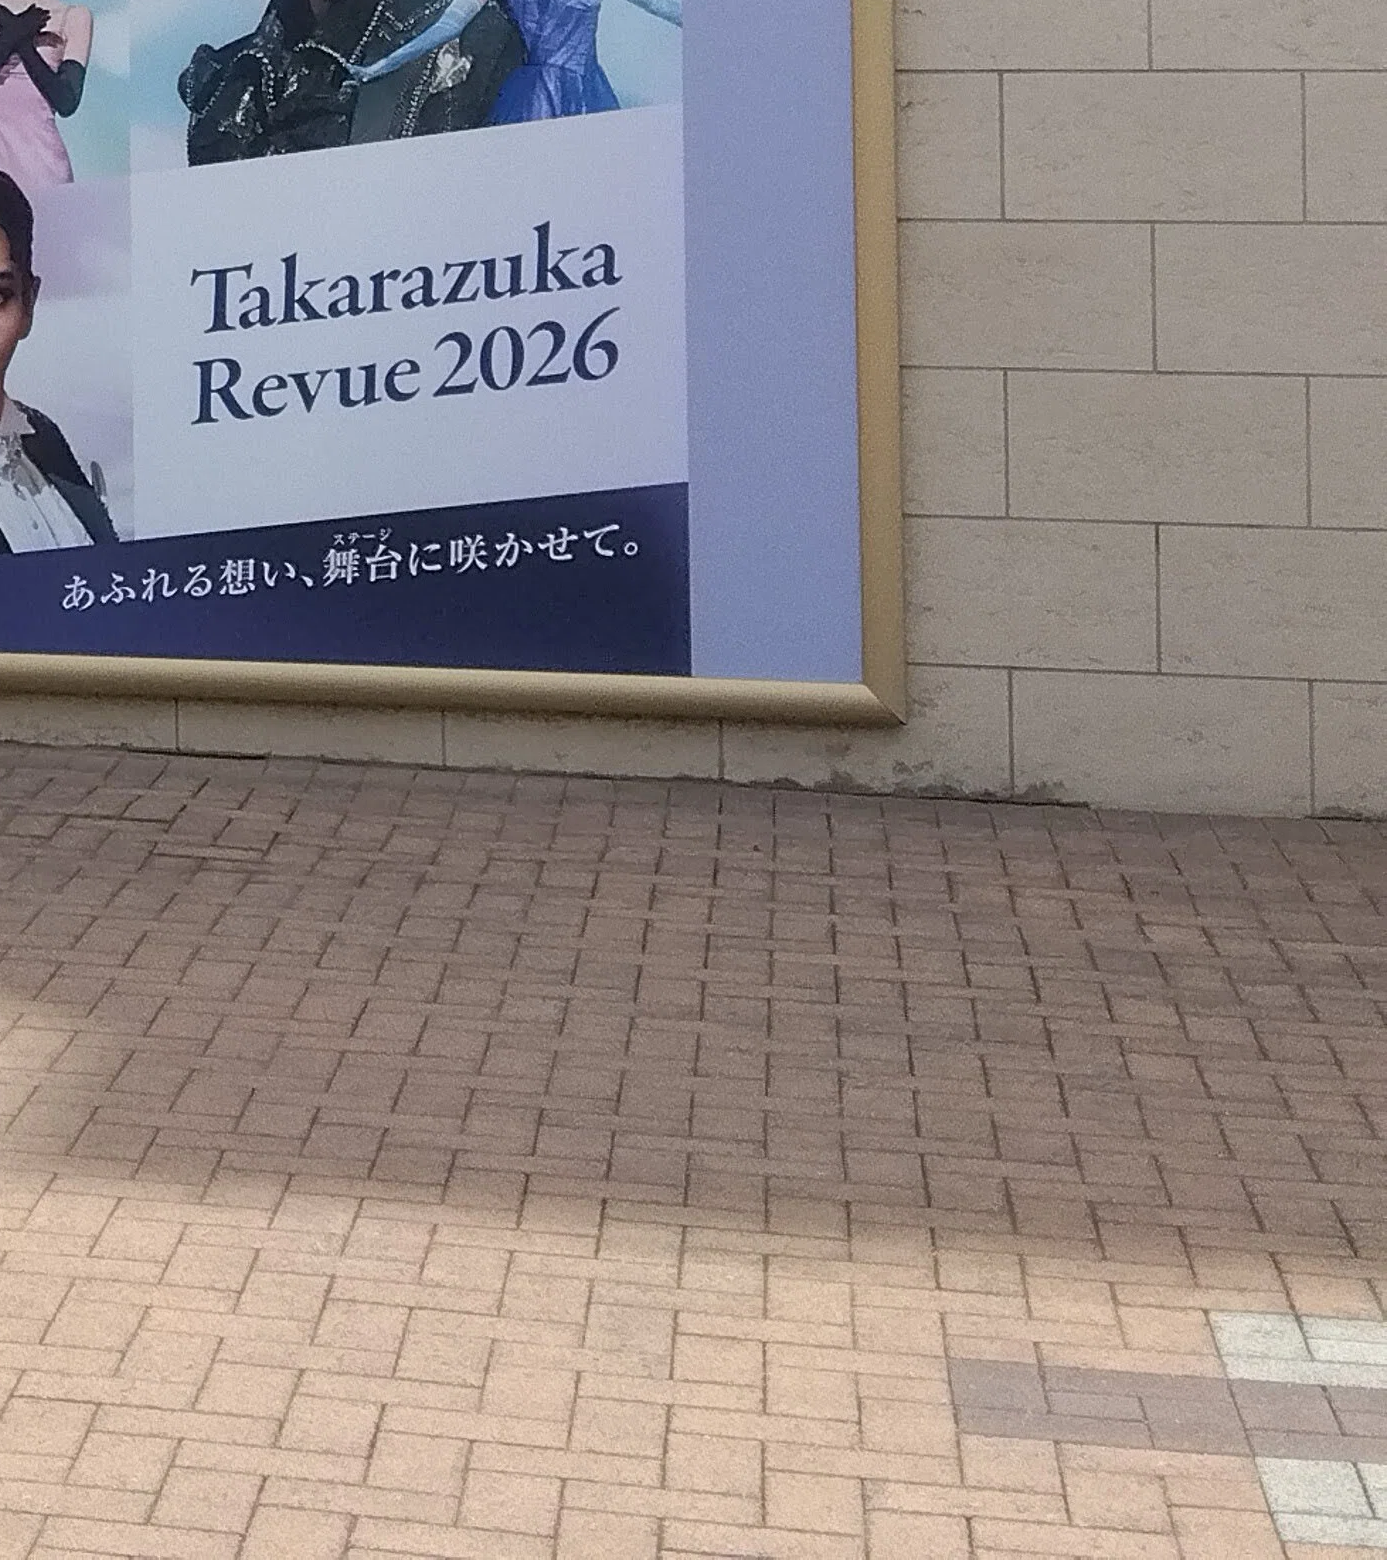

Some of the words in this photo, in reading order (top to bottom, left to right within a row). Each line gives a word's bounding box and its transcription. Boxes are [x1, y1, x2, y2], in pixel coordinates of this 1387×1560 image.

[190, 220, 623, 334] Takarazuka
[191, 351, 421, 425] Revue
[432, 307, 621, 398] 2026
[61, 523, 640, 613] あふれる想い、舞台に咲かせて。
[332, 527, 394, 547] ステージ
